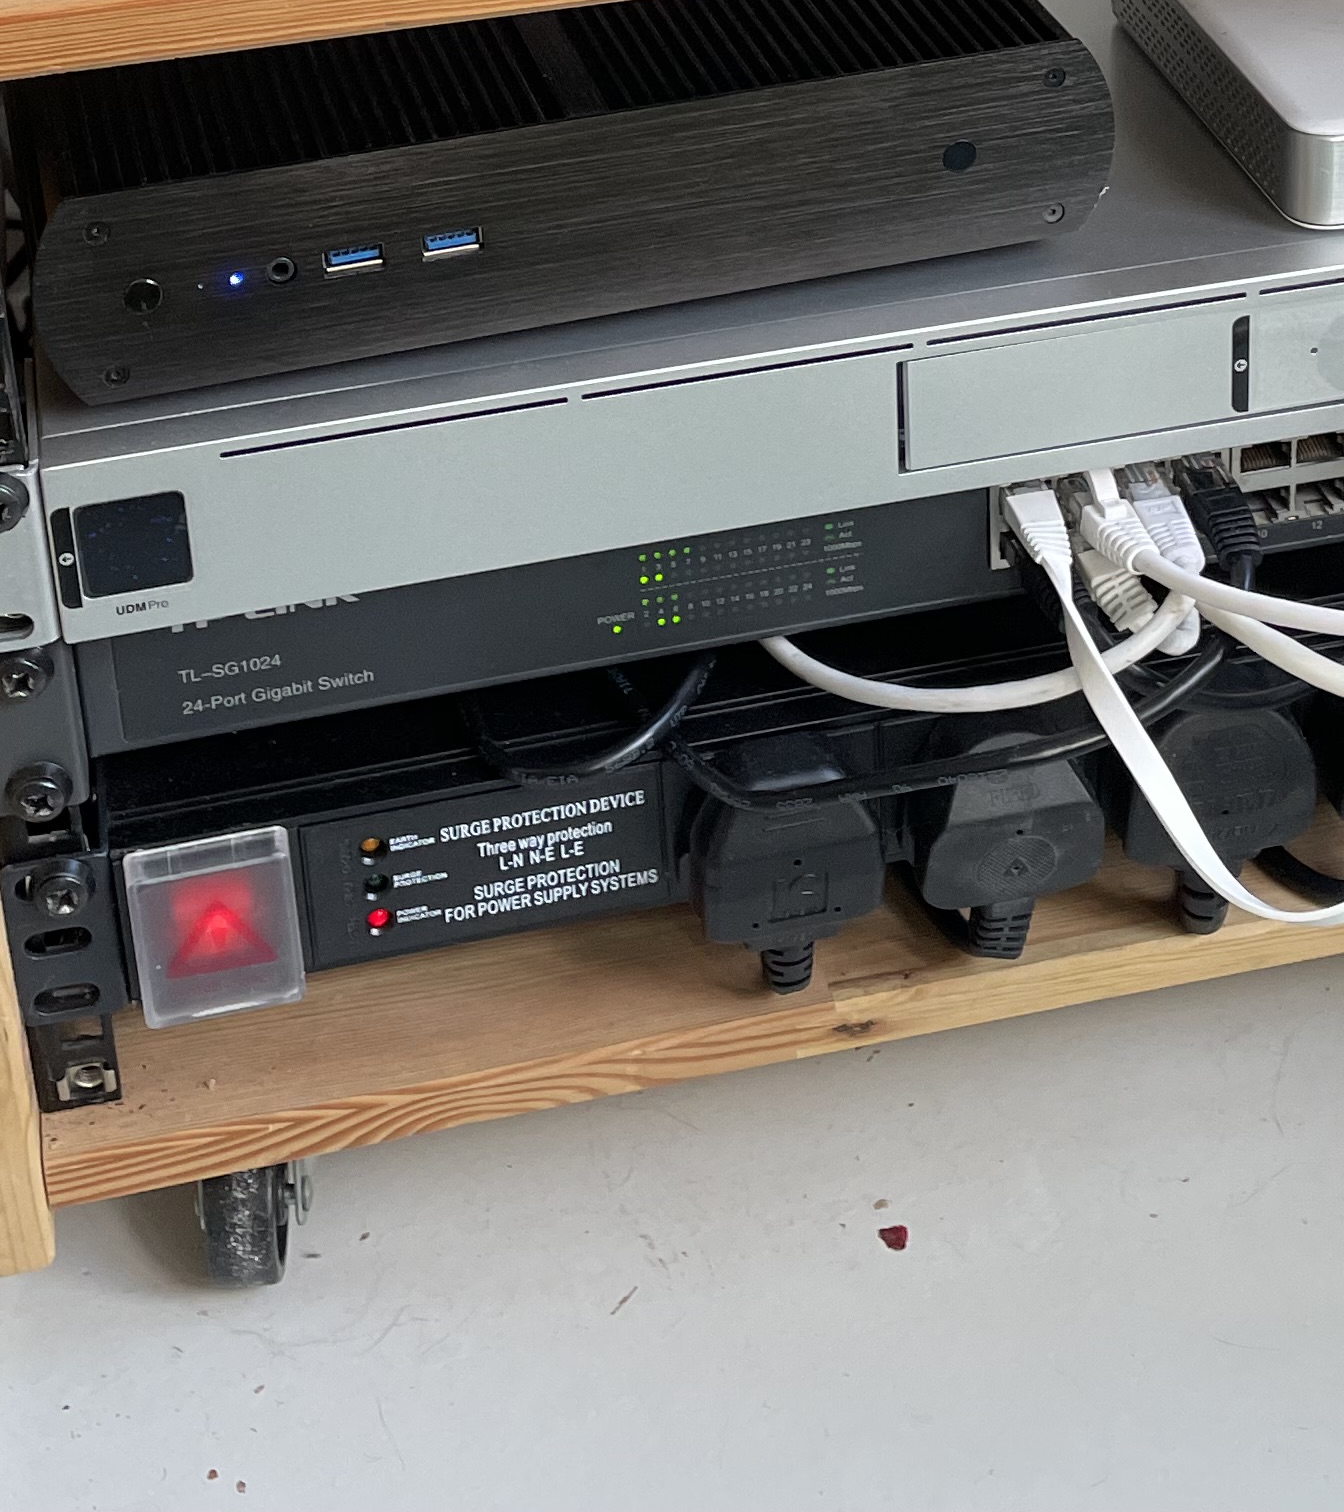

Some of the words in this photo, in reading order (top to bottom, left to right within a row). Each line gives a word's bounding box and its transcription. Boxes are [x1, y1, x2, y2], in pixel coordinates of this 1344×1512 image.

[1311, 519, 1323, 530] 12
[115, 601, 147, 616] UDM
[597, 611, 635, 625] POWER
[177, 653, 283, 685] TL-SG1024
[182, 691, 247, 716] 24-Port
[251, 679, 314, 704] Gigabit
[317, 668, 375, 692] Switch
[439, 818, 492, 843] SURGE
[493, 801, 588, 833] PROTECTION
[589, 789, 646, 815] DEVICE
[476, 839, 517, 858] Three
[517, 833, 546, 851] way
[546, 820, 614, 847] protection
[498, 852, 525, 871] L-N
[529, 845, 556, 865] N-E
[560, 839, 585, 859] L-E
[444, 903, 477, 924] FOR
[477, 893, 532, 917] POWER
[533, 882, 590, 906] SUPPLY
[590, 868, 660, 895] SYSTEMS
[473, 878, 526, 901] SURGE
[527, 858, 622, 890] PROTECTION
